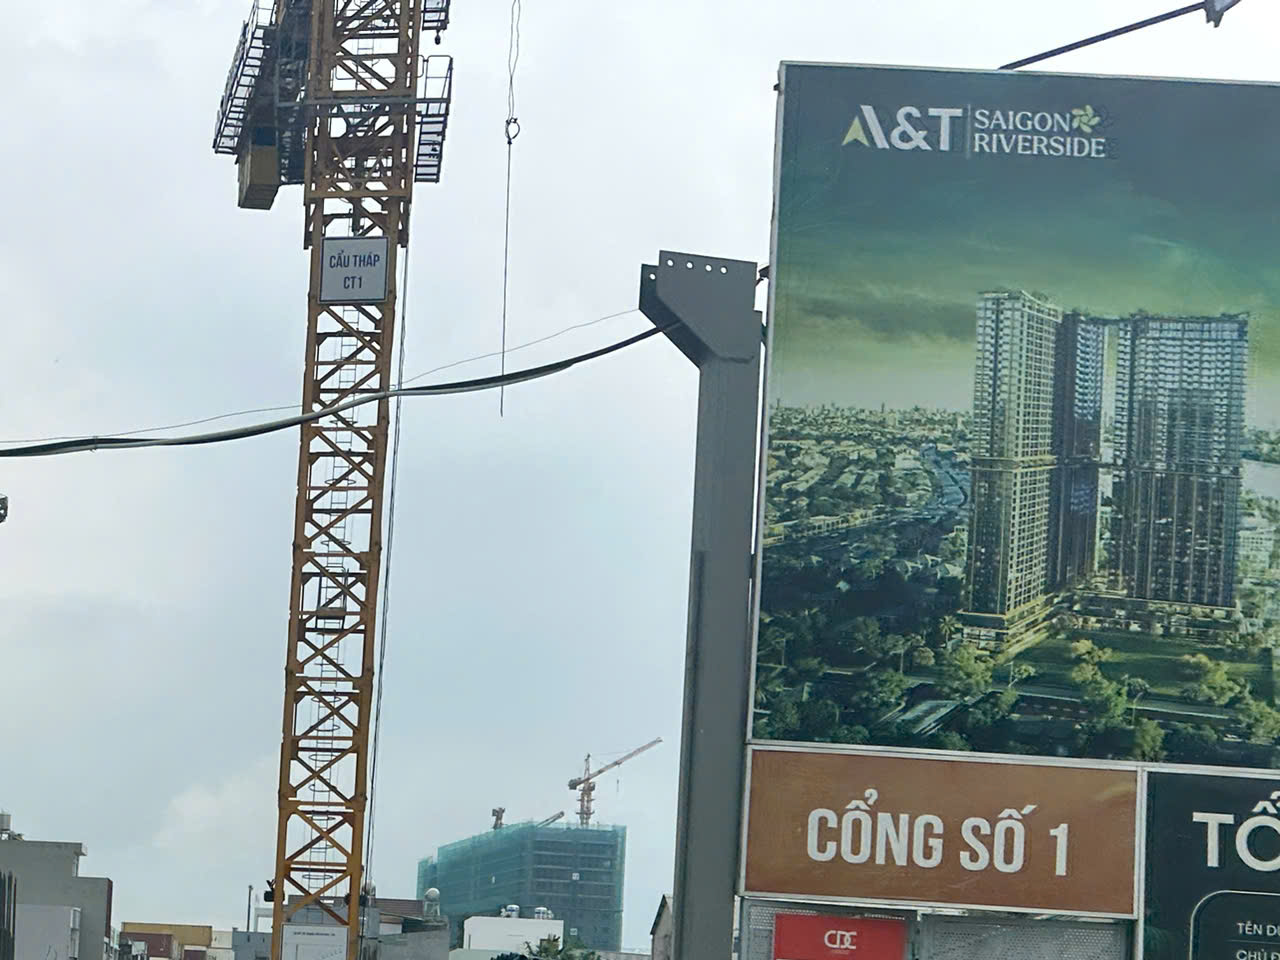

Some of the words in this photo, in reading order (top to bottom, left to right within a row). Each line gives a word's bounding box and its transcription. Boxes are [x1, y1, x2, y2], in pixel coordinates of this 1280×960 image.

[841, 104, 963, 152] A&T
[973, 109, 1072, 133] SAIGON
[972, 134, 1107, 158] RIVERSIDE
[353, 252, 380, 267] THÁP
[806, 787, 943, 868] CỔNG
[959, 804, 1037, 873] SỐ
[1049, 823, 1069, 876] 1
[1236, 920, 1263, 935] TÊN
[824, 930, 857, 950] CDC
